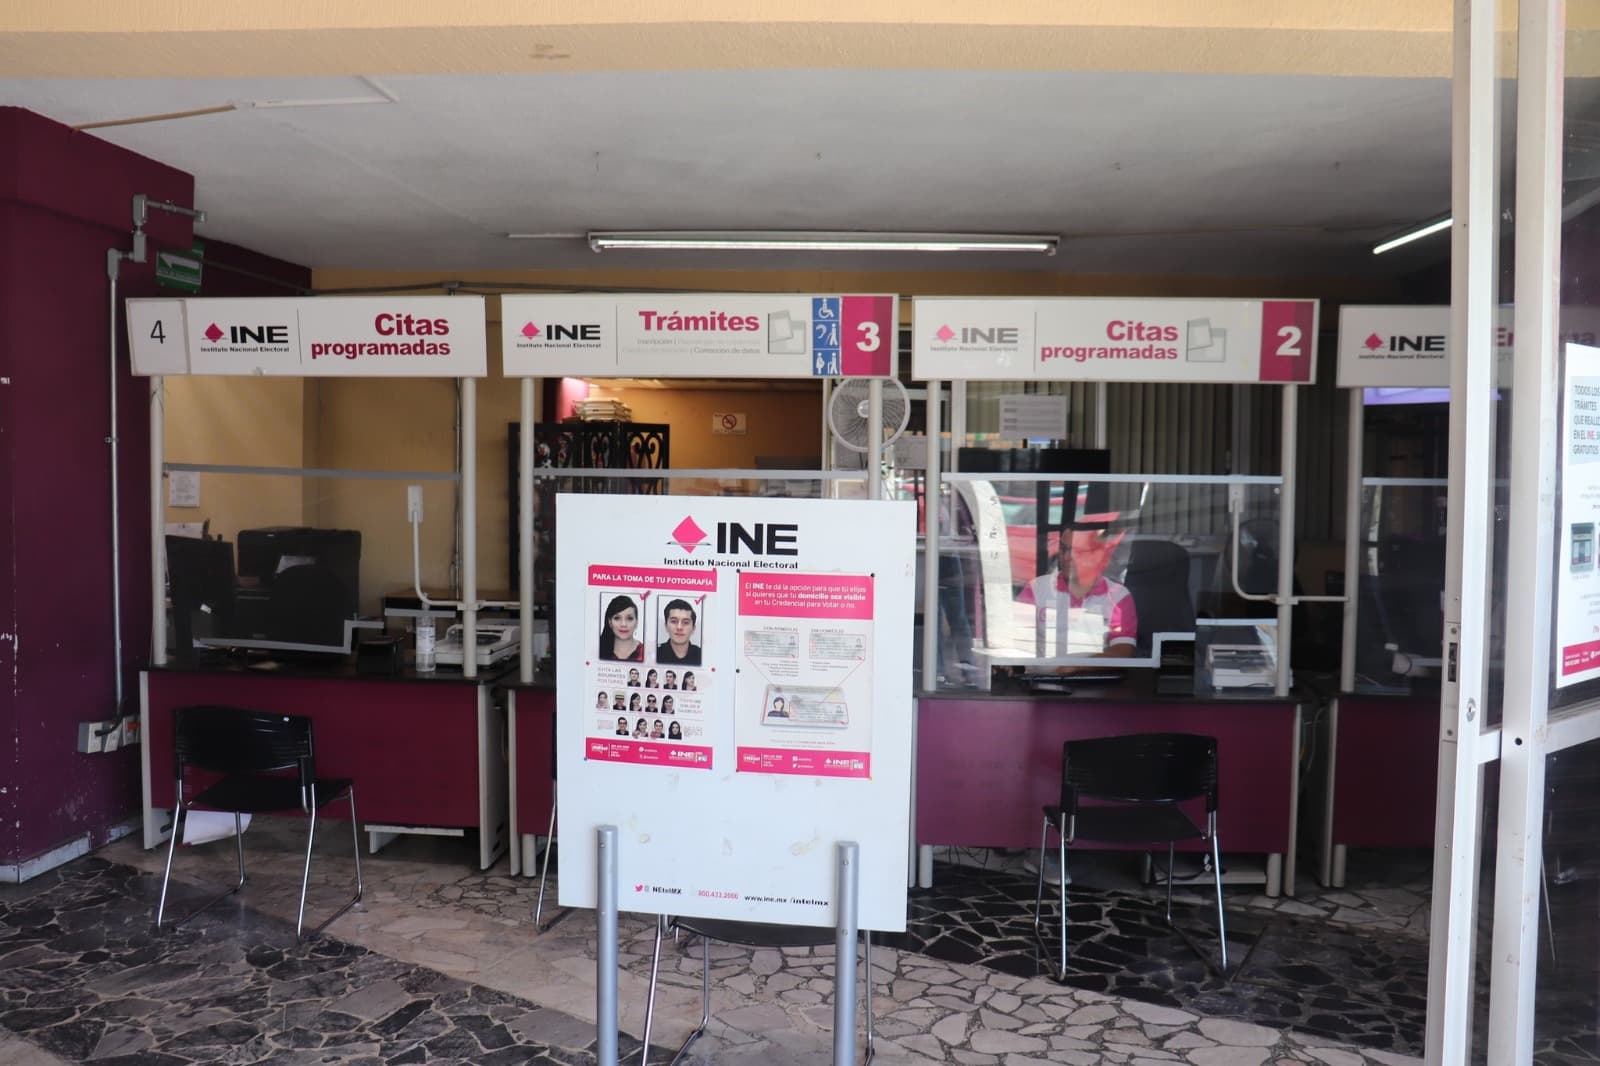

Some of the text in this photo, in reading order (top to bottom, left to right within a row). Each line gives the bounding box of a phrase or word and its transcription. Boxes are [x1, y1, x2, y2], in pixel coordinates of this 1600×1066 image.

[374, 313, 449, 336] Citas
[638, 309, 760, 332] Trámites
[1106, 320, 1178, 342] Citas
[150, 319, 166, 345] 4
[230, 325, 289, 344] INE
[545, 324, 600, 341] INE
[856, 321, 881, 352] 3
[961, 327, 1019, 344] INE
[1275, 326, 1302, 356] 2
[311, 339, 451, 360] programadas
[1041, 344, 1178, 362] programadas
[1390, 335, 1446, 351] INE
[717, 522, 799, 556] INE
[664, 557, 798, 570] Instituto Nacional Electoral
[592, 572, 713, 586] PARA LA TOMA DE TU FOTOGRAFÍA
